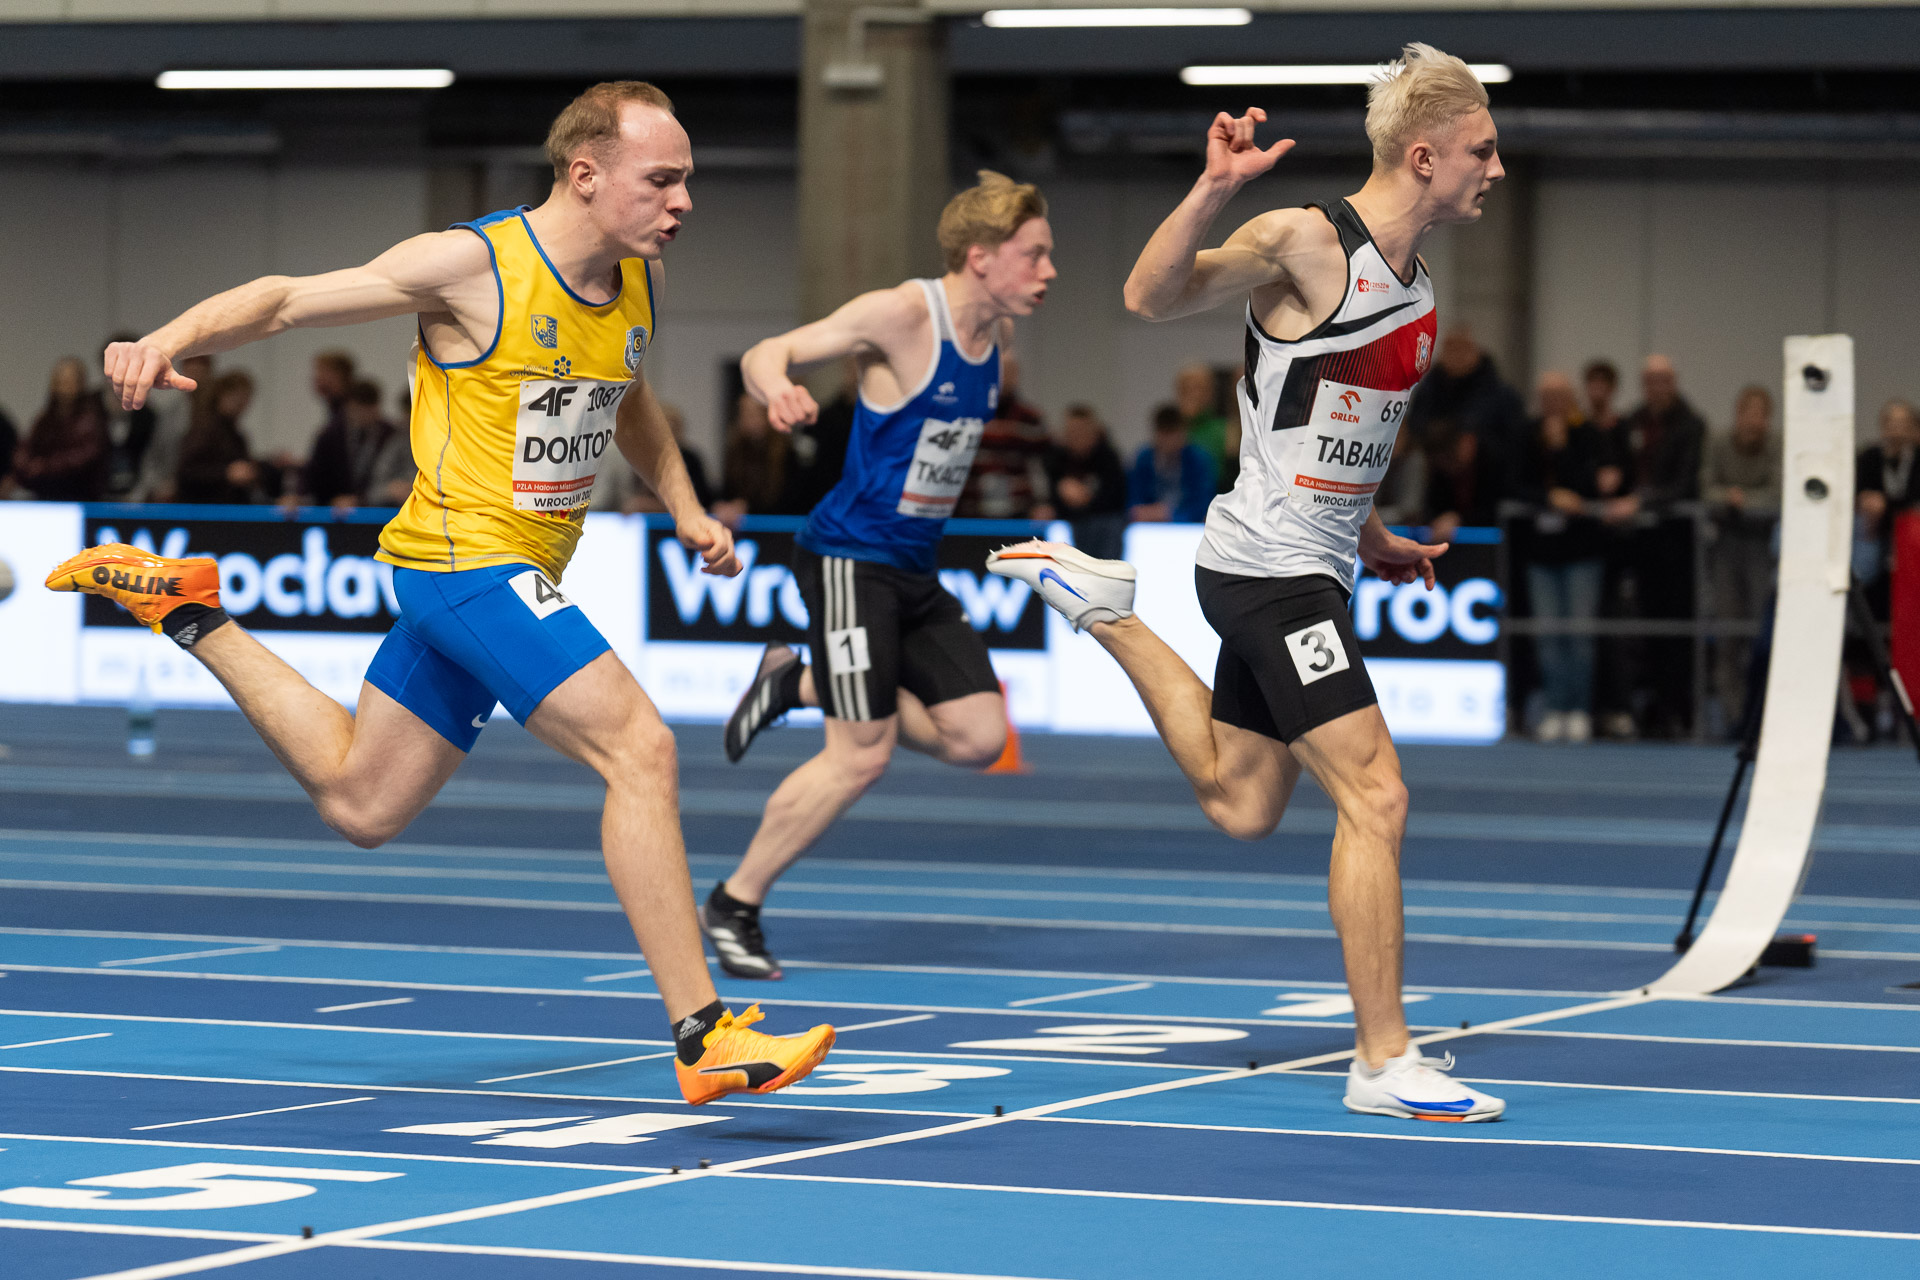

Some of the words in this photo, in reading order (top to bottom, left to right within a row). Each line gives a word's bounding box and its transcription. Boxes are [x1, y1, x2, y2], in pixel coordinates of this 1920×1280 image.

[527, 385, 579, 417] 4F
[587, 385, 627, 412] 1087
[1330, 411, 1360, 424] ORLEN
[928, 429, 962, 451] 4F
[516, 481, 533, 491] PZLA
[533, 484, 559, 492] Halowe
[1298, 477, 1315, 487] PZLA
[1313, 494, 1358, 507] WROCŁAW
[92, 565, 188, 597] NITRO
[534, 573, 566, 604] 4
[839, 634, 856, 668] 1
[1300, 630, 1335, 672] 3
[947, 1023, 1250, 1055] 2
[774, 1063, 1013, 1096] 3
[380, 1112, 737, 1149] 4
[0, 1162, 408, 1211] 5
